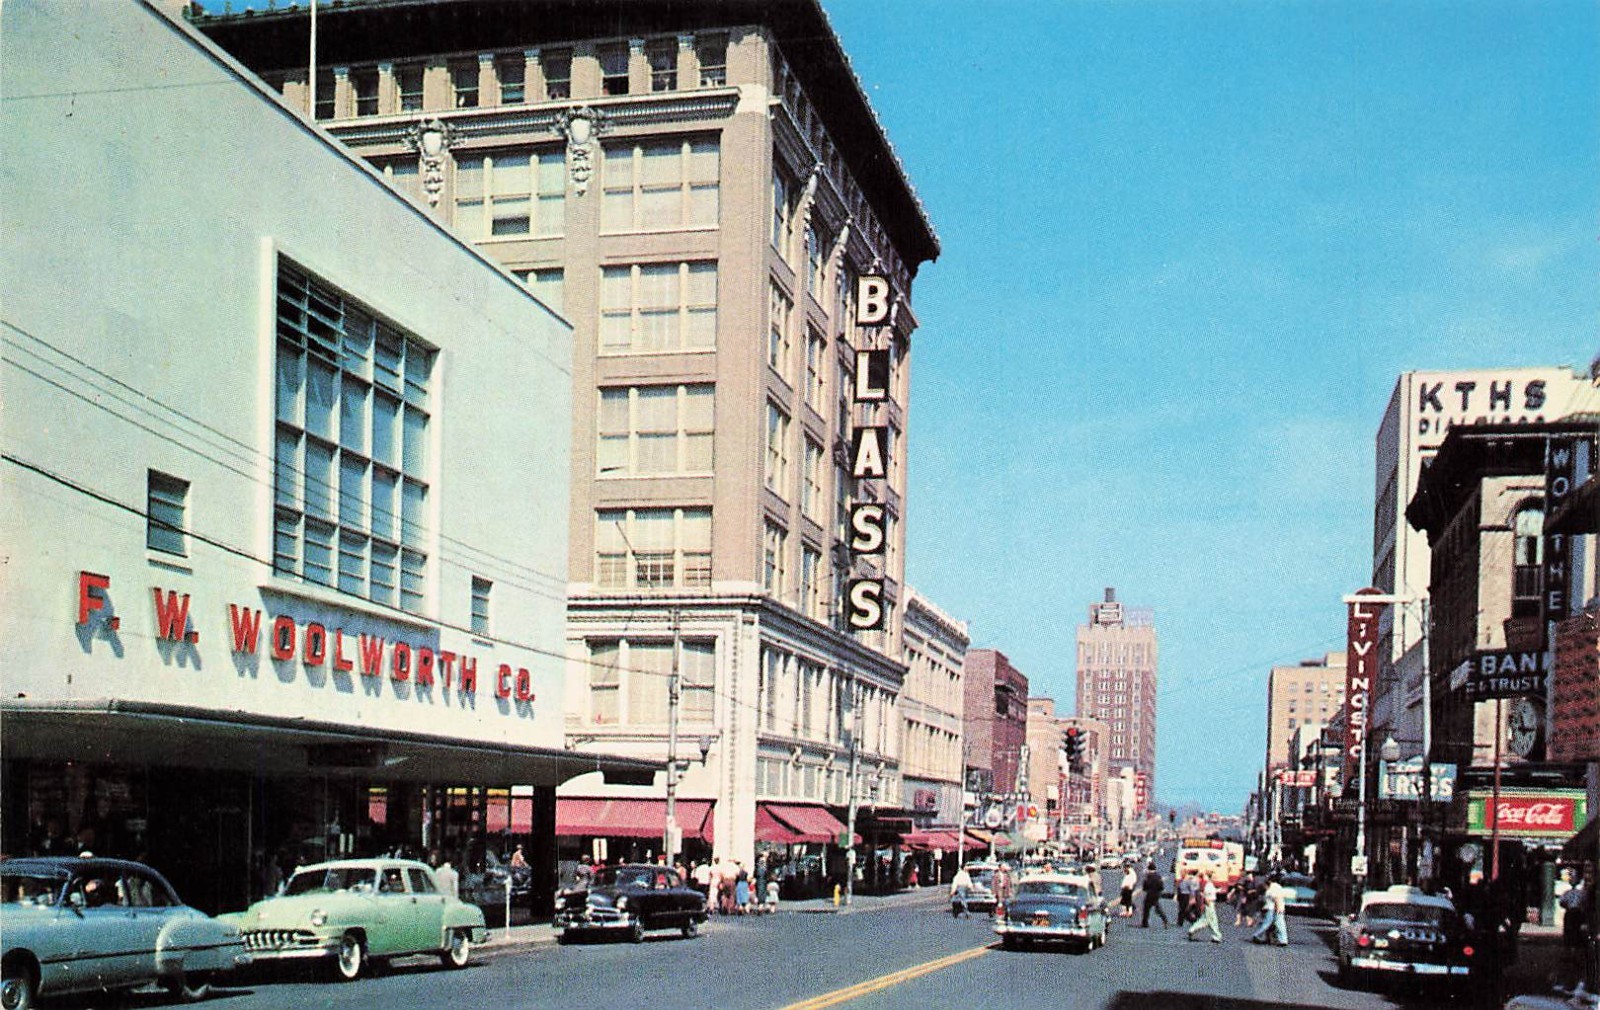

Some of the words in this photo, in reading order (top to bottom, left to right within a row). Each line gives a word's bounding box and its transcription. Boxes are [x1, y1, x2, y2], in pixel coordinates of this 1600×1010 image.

[1419, 379, 1547, 412] KTHS
[851, 275, 889, 628] BLASS
[78, 571, 120, 631] F.
[153, 587, 199, 644] W.
[228, 603, 477, 693] WOOLWORTH
[496, 663, 535, 702] CO.
[1489, 676, 1540, 691] TRUST
